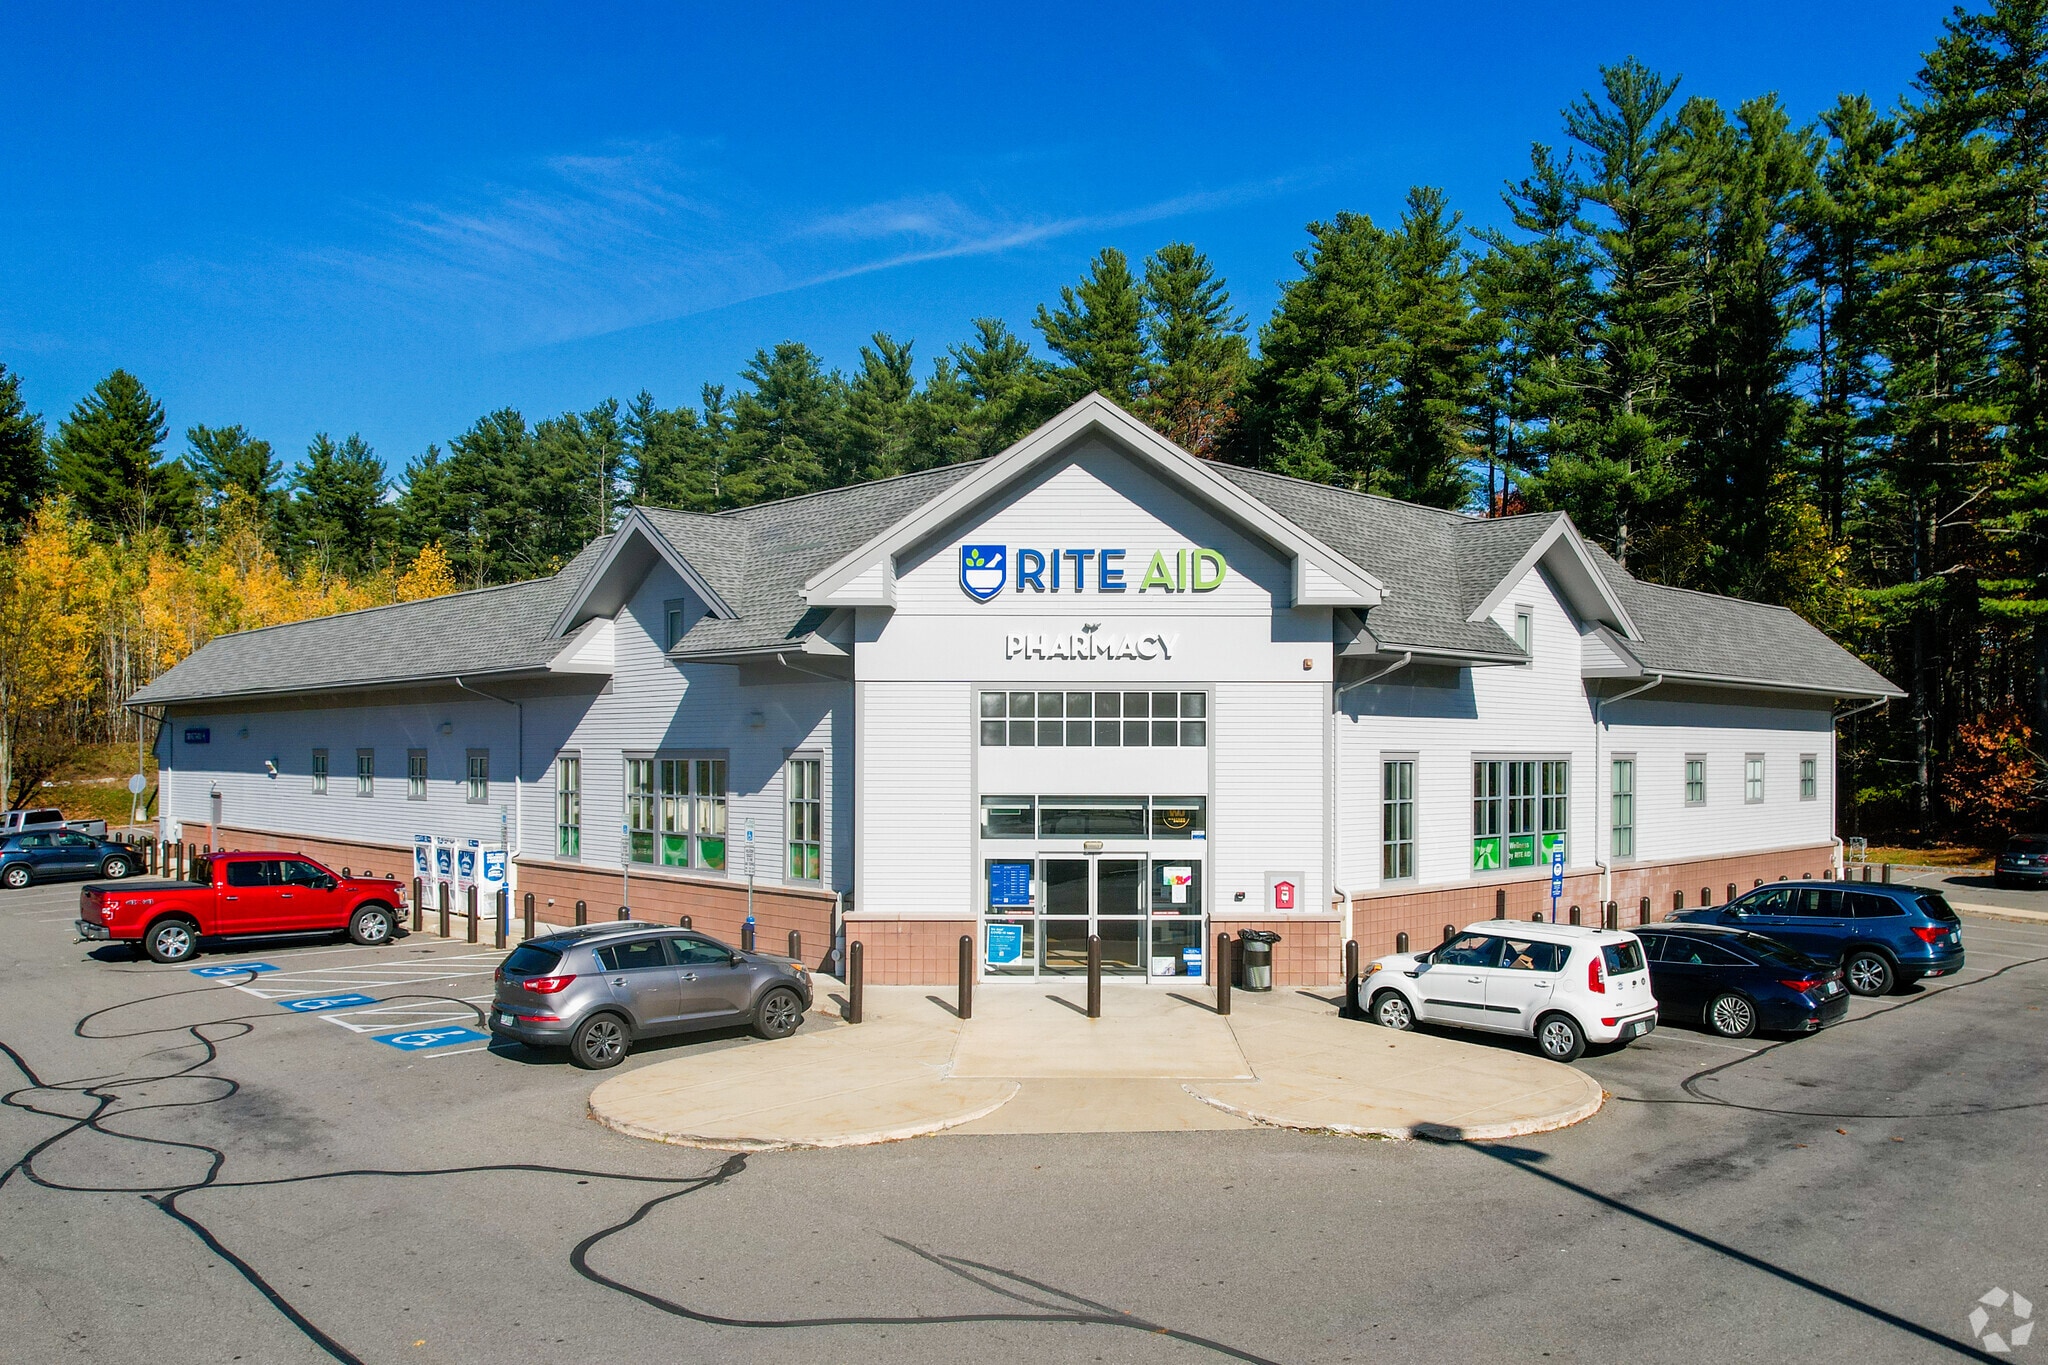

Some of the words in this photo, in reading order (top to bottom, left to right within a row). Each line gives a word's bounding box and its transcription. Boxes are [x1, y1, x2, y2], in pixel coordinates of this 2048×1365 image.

[1016, 548, 1128, 592] RITE
[1139, 548, 1227, 592] AID
[1005, 632, 1181, 660] PHARMACY
[1514, 851, 1524, 859] RITE
